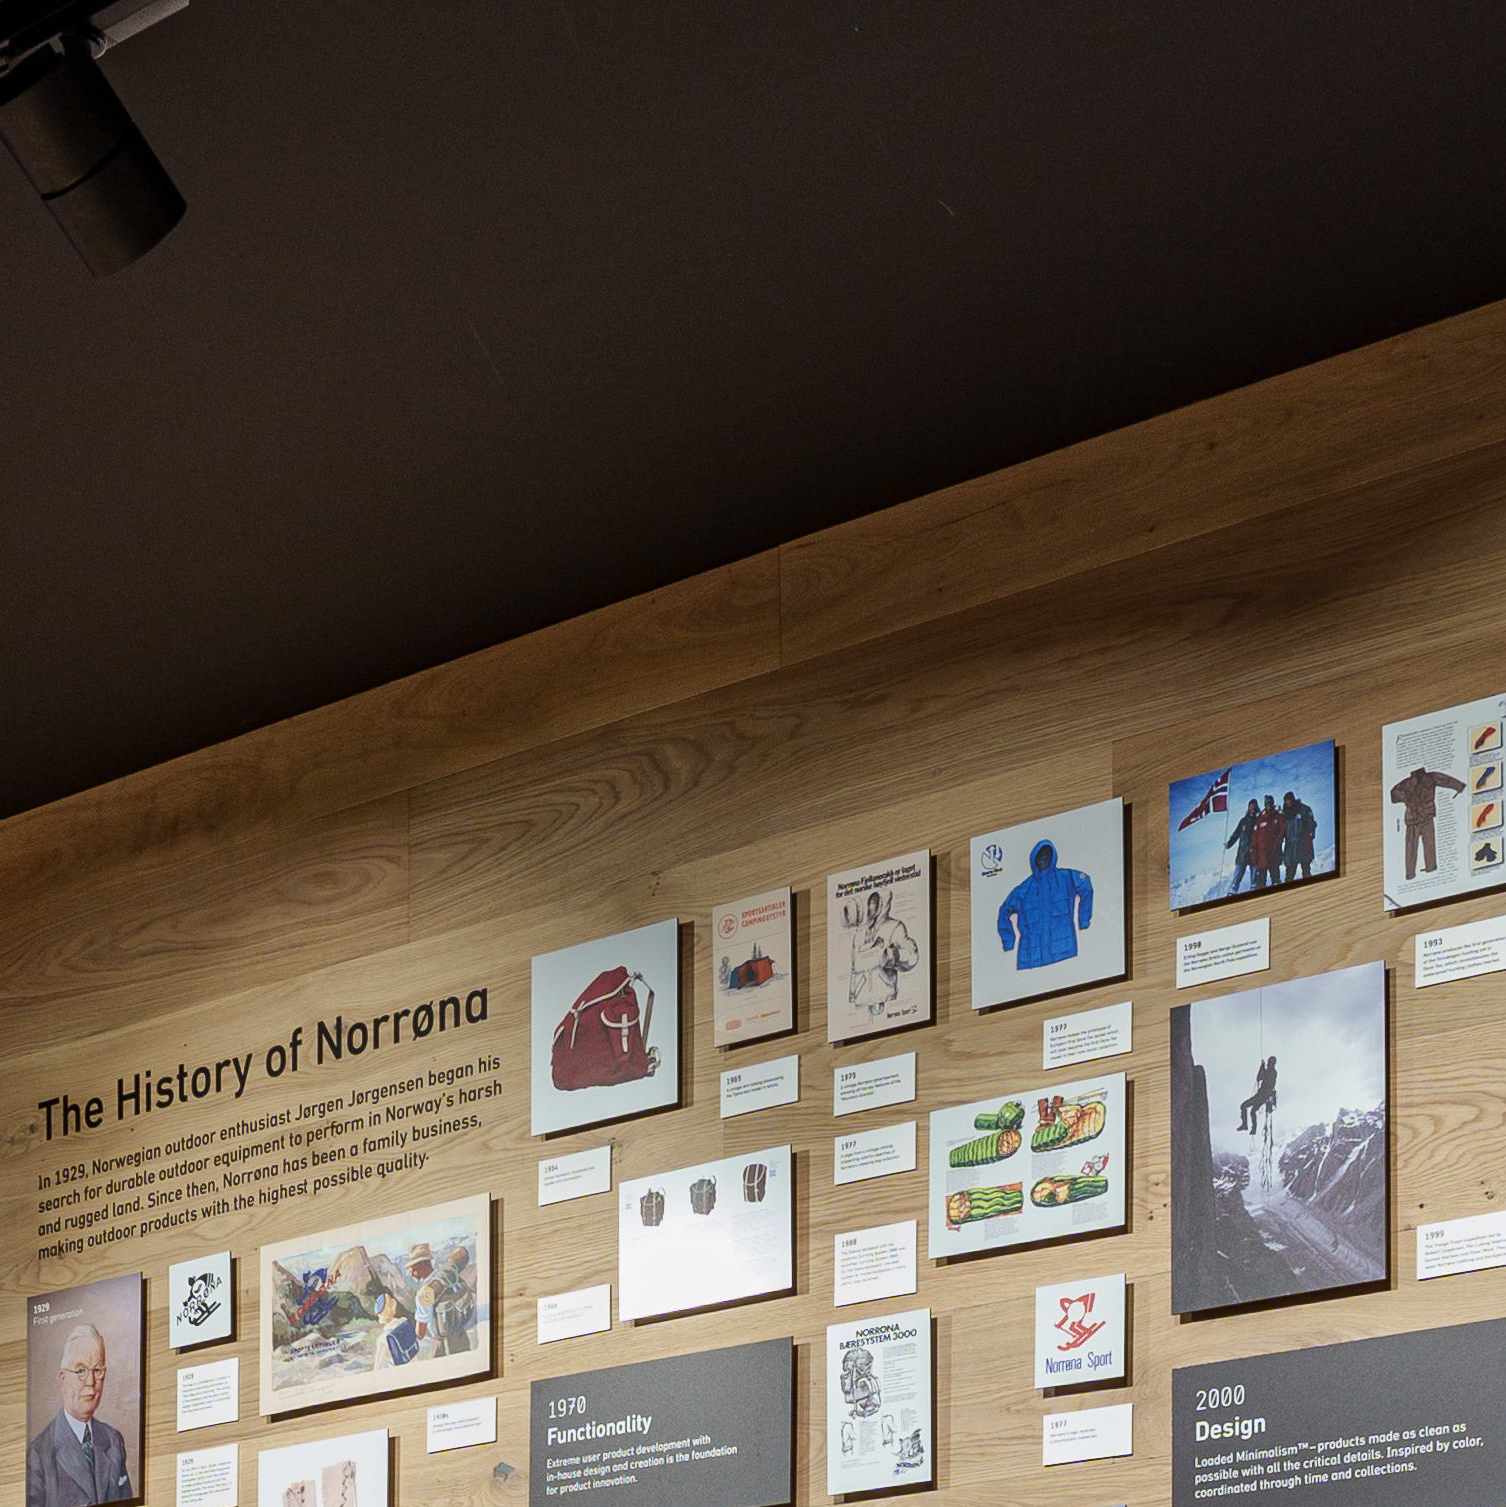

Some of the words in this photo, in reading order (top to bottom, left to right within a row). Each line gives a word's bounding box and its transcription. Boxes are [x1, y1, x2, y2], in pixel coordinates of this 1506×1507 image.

[38, 1096, 104, 1141] The
[116, 1053, 253, 1120] History
[266, 1027, 303, 1077] of
[317, 987, 489, 1065] Norrøna
[38, 1175, 50, 1190] In
[55, 1164, 88, 1185] 1929,
[92, 1146, 161, 1175] Norwegian
[165, 1131, 216, 1155] outdoor
[220, 1109, 291, 1140] enthusiast
[295, 1098, 343, 1121] Jørgen
[348, 1077, 423, 1107] Jørgensen
[429, 1064, 473, 1086] began
[478, 1055, 500, 1073] his
[38, 1189, 80, 1213] search
[84, 1186, 102, 1201] for
[106, 1170, 155, 1195] durable
[159, 1158, 210, 1181] outdoor
[214, 1135, 285, 1167] equipment
[289, 1133, 302, 1147] to
[307, 1118, 364, 1147] perform
[369, 1111, 381, 1127] in
[386, 1093, 454, 1123] Norway's
[459, 1080, 502, 1104] harsh
[38, 1217, 61, 1236] and
[65, 1204, 108, 1230] rugged
[113, 1196, 144, 1217] land.
[148, 1189, 182, 1208] Since
[186, 1180, 219, 1198] then,
[223, 1165, 278, 1189] Norrøna
[283, 1157, 308, 1174] has
[312, 1148, 345, 1166] been
[350, 1144, 358, 1157] a
[363, 1130, 407, 1154] family
[412, 1115, 482, 1141] business,
[38, 1238, 83, 1260] making
[88, 1225, 137, 1247] outdoor
[140, 1209, 197, 1238] products
[201, 1198, 230, 1218] with
[234, 1194, 255, 1211] the
[259, 1179, 308, 1205] highest
[313, 1164, 372, 1195] possible
[893, 1328, 917, 1341] 3000
[1087, 1351, 1112, 1371] Sport
[548, 1395, 586, 1419] 1970
[1196, 1384, 1245, 1410] 2000
[547, 1414, 652, 1445] Functionality
[1195, 1452, 1233, 1468] Loaded
[1369, 1431, 1400, 1444] made
[1402, 1430, 1416, 1439] as
[1419, 1426, 1450, 1437] clean
[1452, 1423, 1466, 1433] as
[1196, 1416, 1266, 1441] Design
[1195, 1468, 1239, 1485] possible
[1241, 1464, 1264, 1477] with
[1267, 1461, 1280, 1474] all
[1283, 1460, 1301, 1471] the
[1303, 1453, 1341, 1469] critical
[1343, 1449, 1384, 1463] details.
[1387, 1441, 1433, 1458] Inspired
[1436, 1440, 1450, 1453] by
[1452, 1436, 1484, 1449] color,
[1195, 1480, 1257, 1499] coordinated
[1260, 1475, 1301, 1490] through
[1304, 1473, 1329, 1484] time
[1331, 1468, 1352, 1481] and
[1355, 1462, 1417, 1478] collections.
